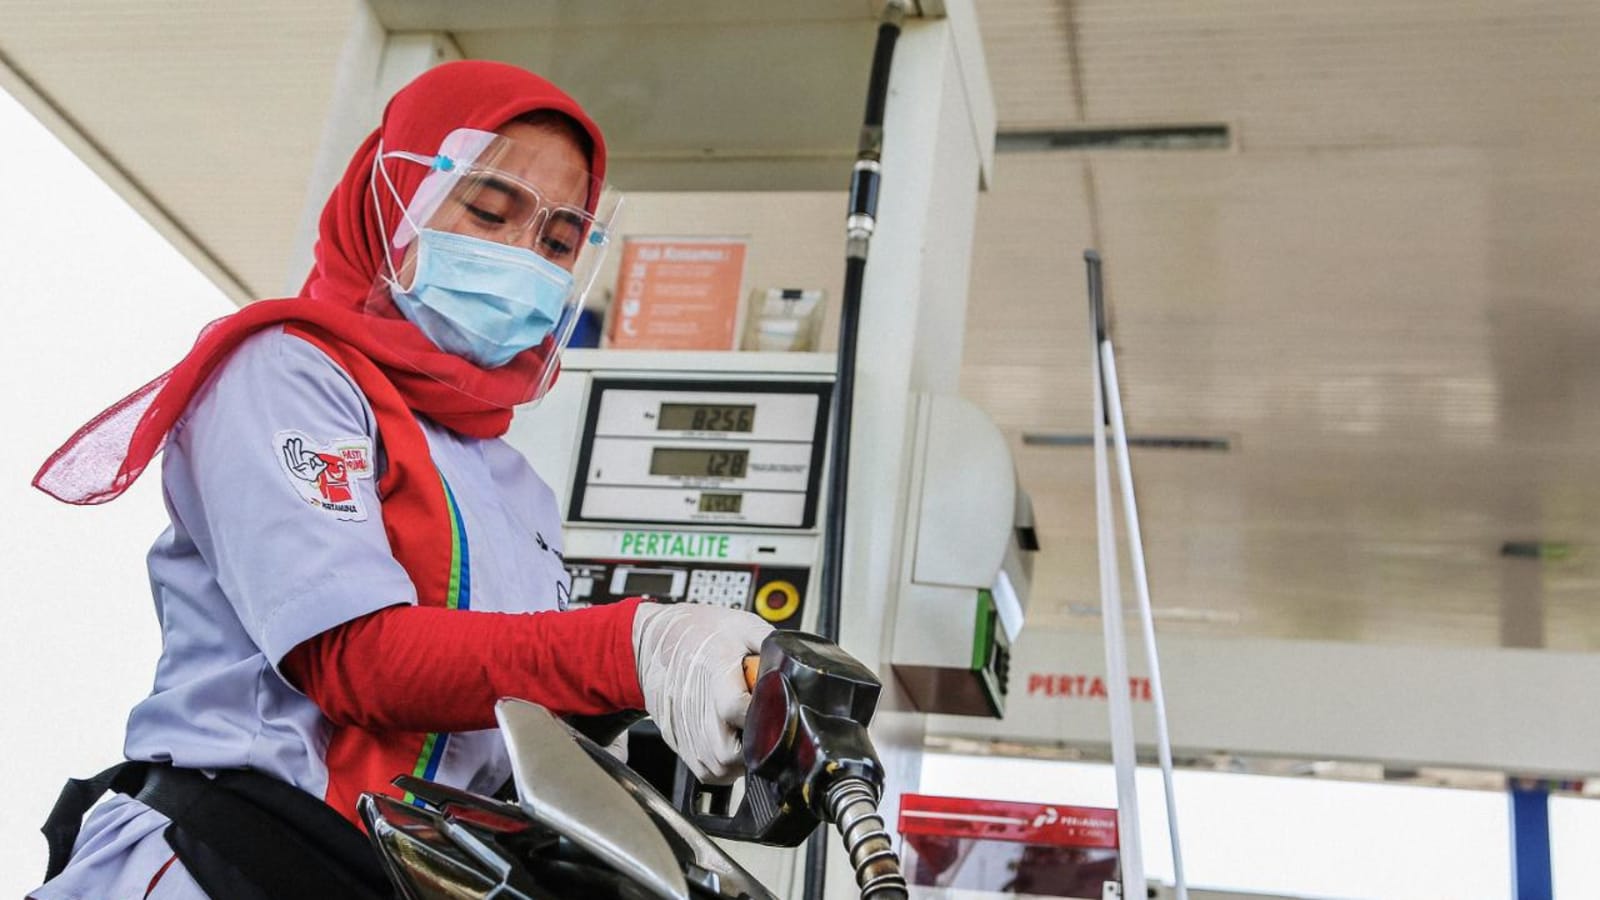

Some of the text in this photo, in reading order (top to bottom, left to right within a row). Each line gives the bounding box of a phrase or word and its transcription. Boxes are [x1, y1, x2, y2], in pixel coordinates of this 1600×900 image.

[691, 409, 750, 431] 8256
[620, 532, 730, 558] PERTALITE
[1028, 674, 1153, 702] PERTATE
